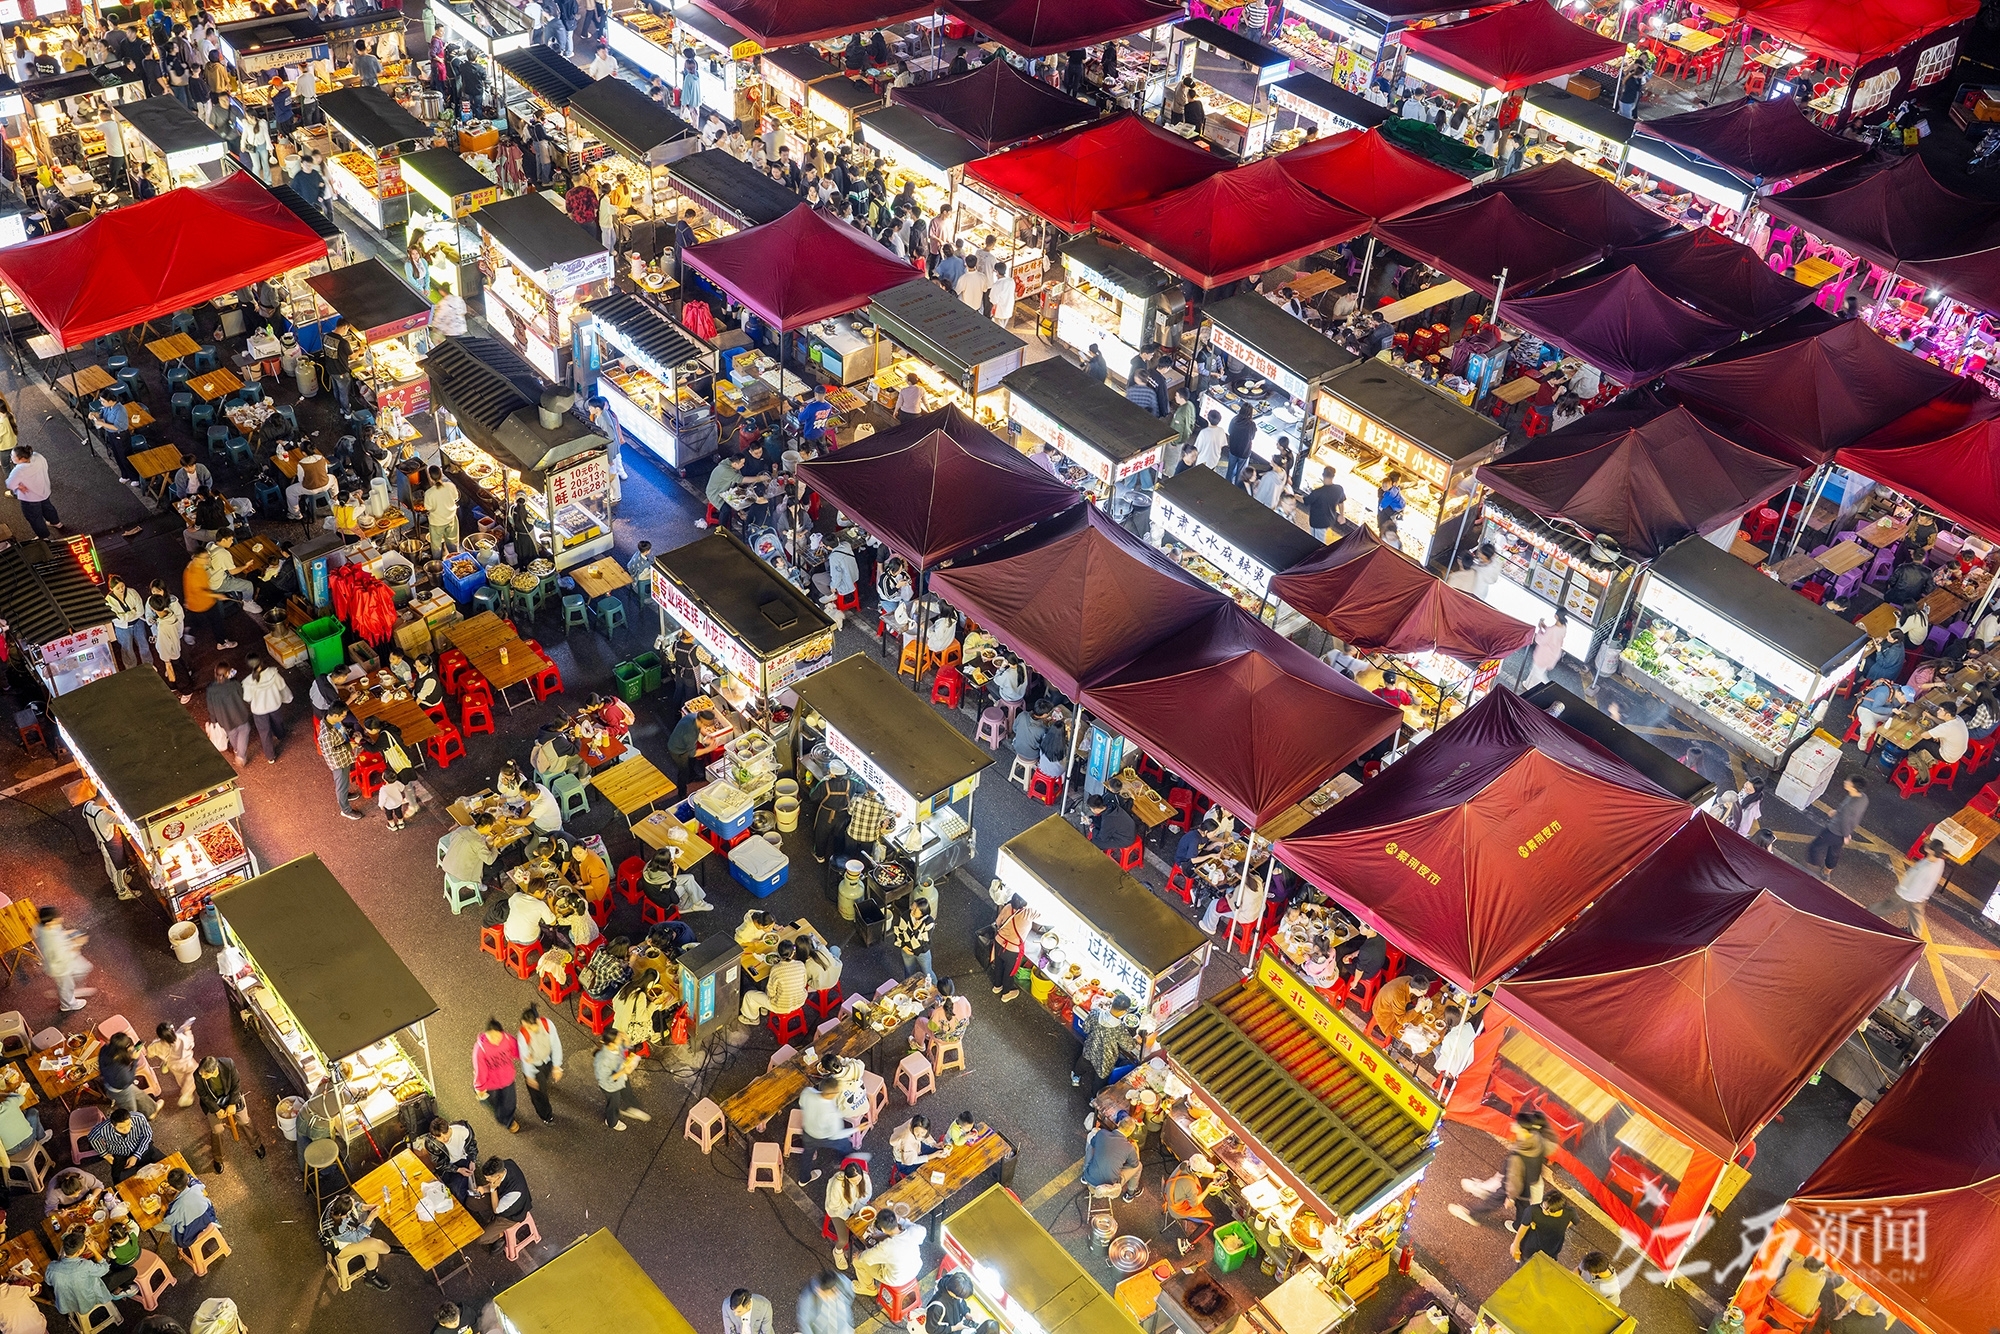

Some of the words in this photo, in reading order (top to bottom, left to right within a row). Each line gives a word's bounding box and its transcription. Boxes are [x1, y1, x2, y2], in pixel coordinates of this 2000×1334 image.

[1213, 328, 1278, 381] 正宗北方馅饼
[1283, 373, 1306, 399] 锅贴
[1119, 454, 1156, 478] 牛杂粉
[1363, 421, 1410, 464] 狼牙土豆
[1411, 450, 1448, 487] 小土豆
[570, 462, 600, 480] 10元6个
[570, 470, 607, 490] 20元13个
[553, 476, 568, 507] 生蚝
[571, 480, 608, 499] 40元28个
[1160, 504, 1265, 589] 甘肃天水麻辣烫
[45, 627, 104, 653] 甘梅薯条
[53, 638, 100, 659] 十元一份
[1526, 819, 1563, 853] 紫荆夜市
[1395, 849, 1442, 886] 紫荆夜市
[1087, 931, 1148, 1000] 过桥米线
[1267, 968, 1428, 1118] 老北京卤肉卷饼
